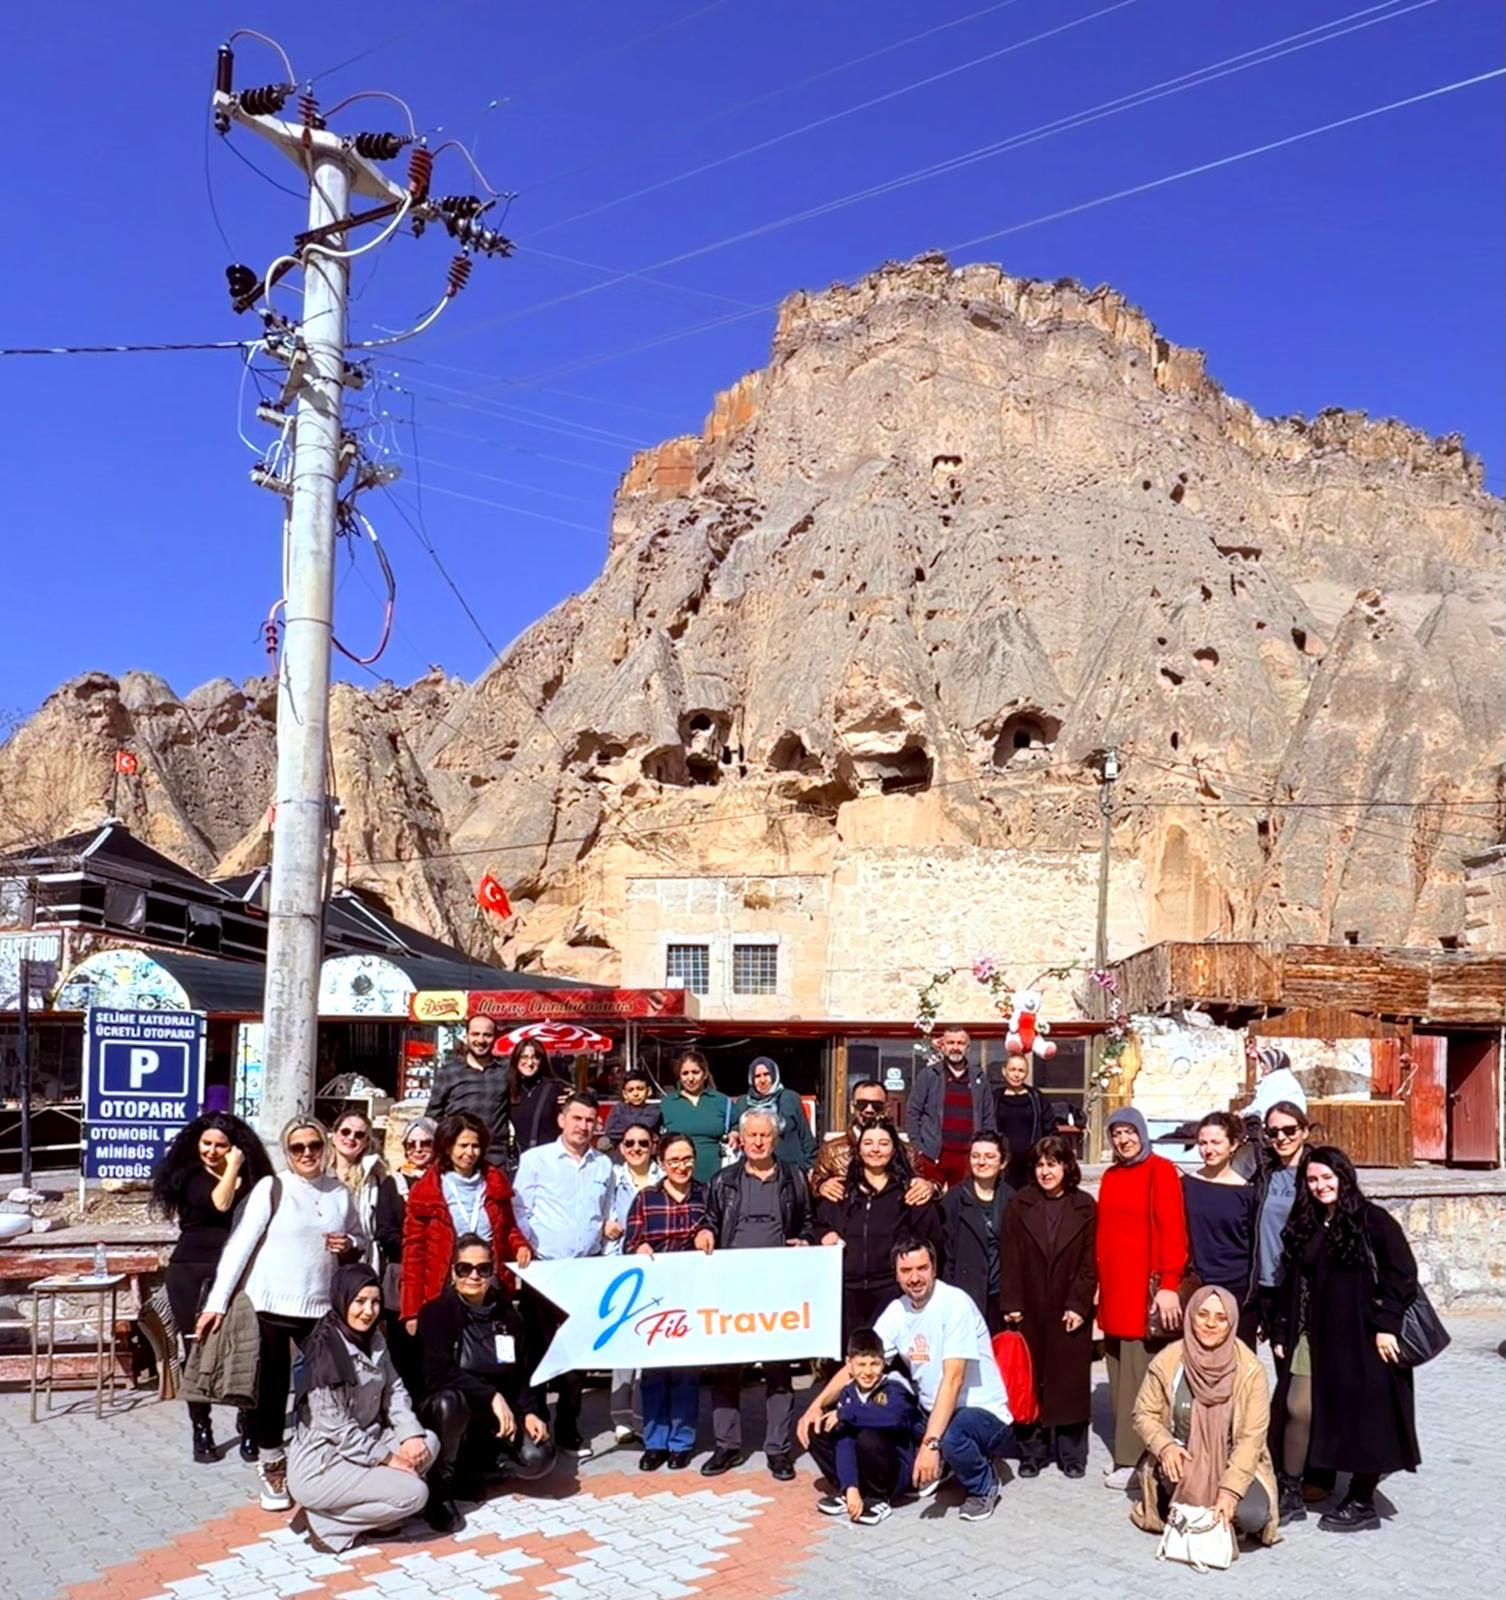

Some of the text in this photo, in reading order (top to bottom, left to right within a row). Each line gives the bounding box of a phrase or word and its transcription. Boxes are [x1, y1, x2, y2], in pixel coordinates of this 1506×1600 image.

[29, 936, 58, 962] FOOD
[96, 1011, 195, 1026] SELİME KATEDRALİ
[96, 1024, 195, 1039] ÜCRETLİ OTOPARKI
[130, 1048, 160, 1088] P
[100, 1100, 186, 1118] OTOPARK
[91, 1126, 160, 1141] OTOMOBİL
[96, 1144, 154, 1159] MİNİBÜS
[98, 1162, 151, 1178] OTOBÜS
[634, 1308, 692, 1346] Fib
[697, 1302, 811, 1336] Travel
